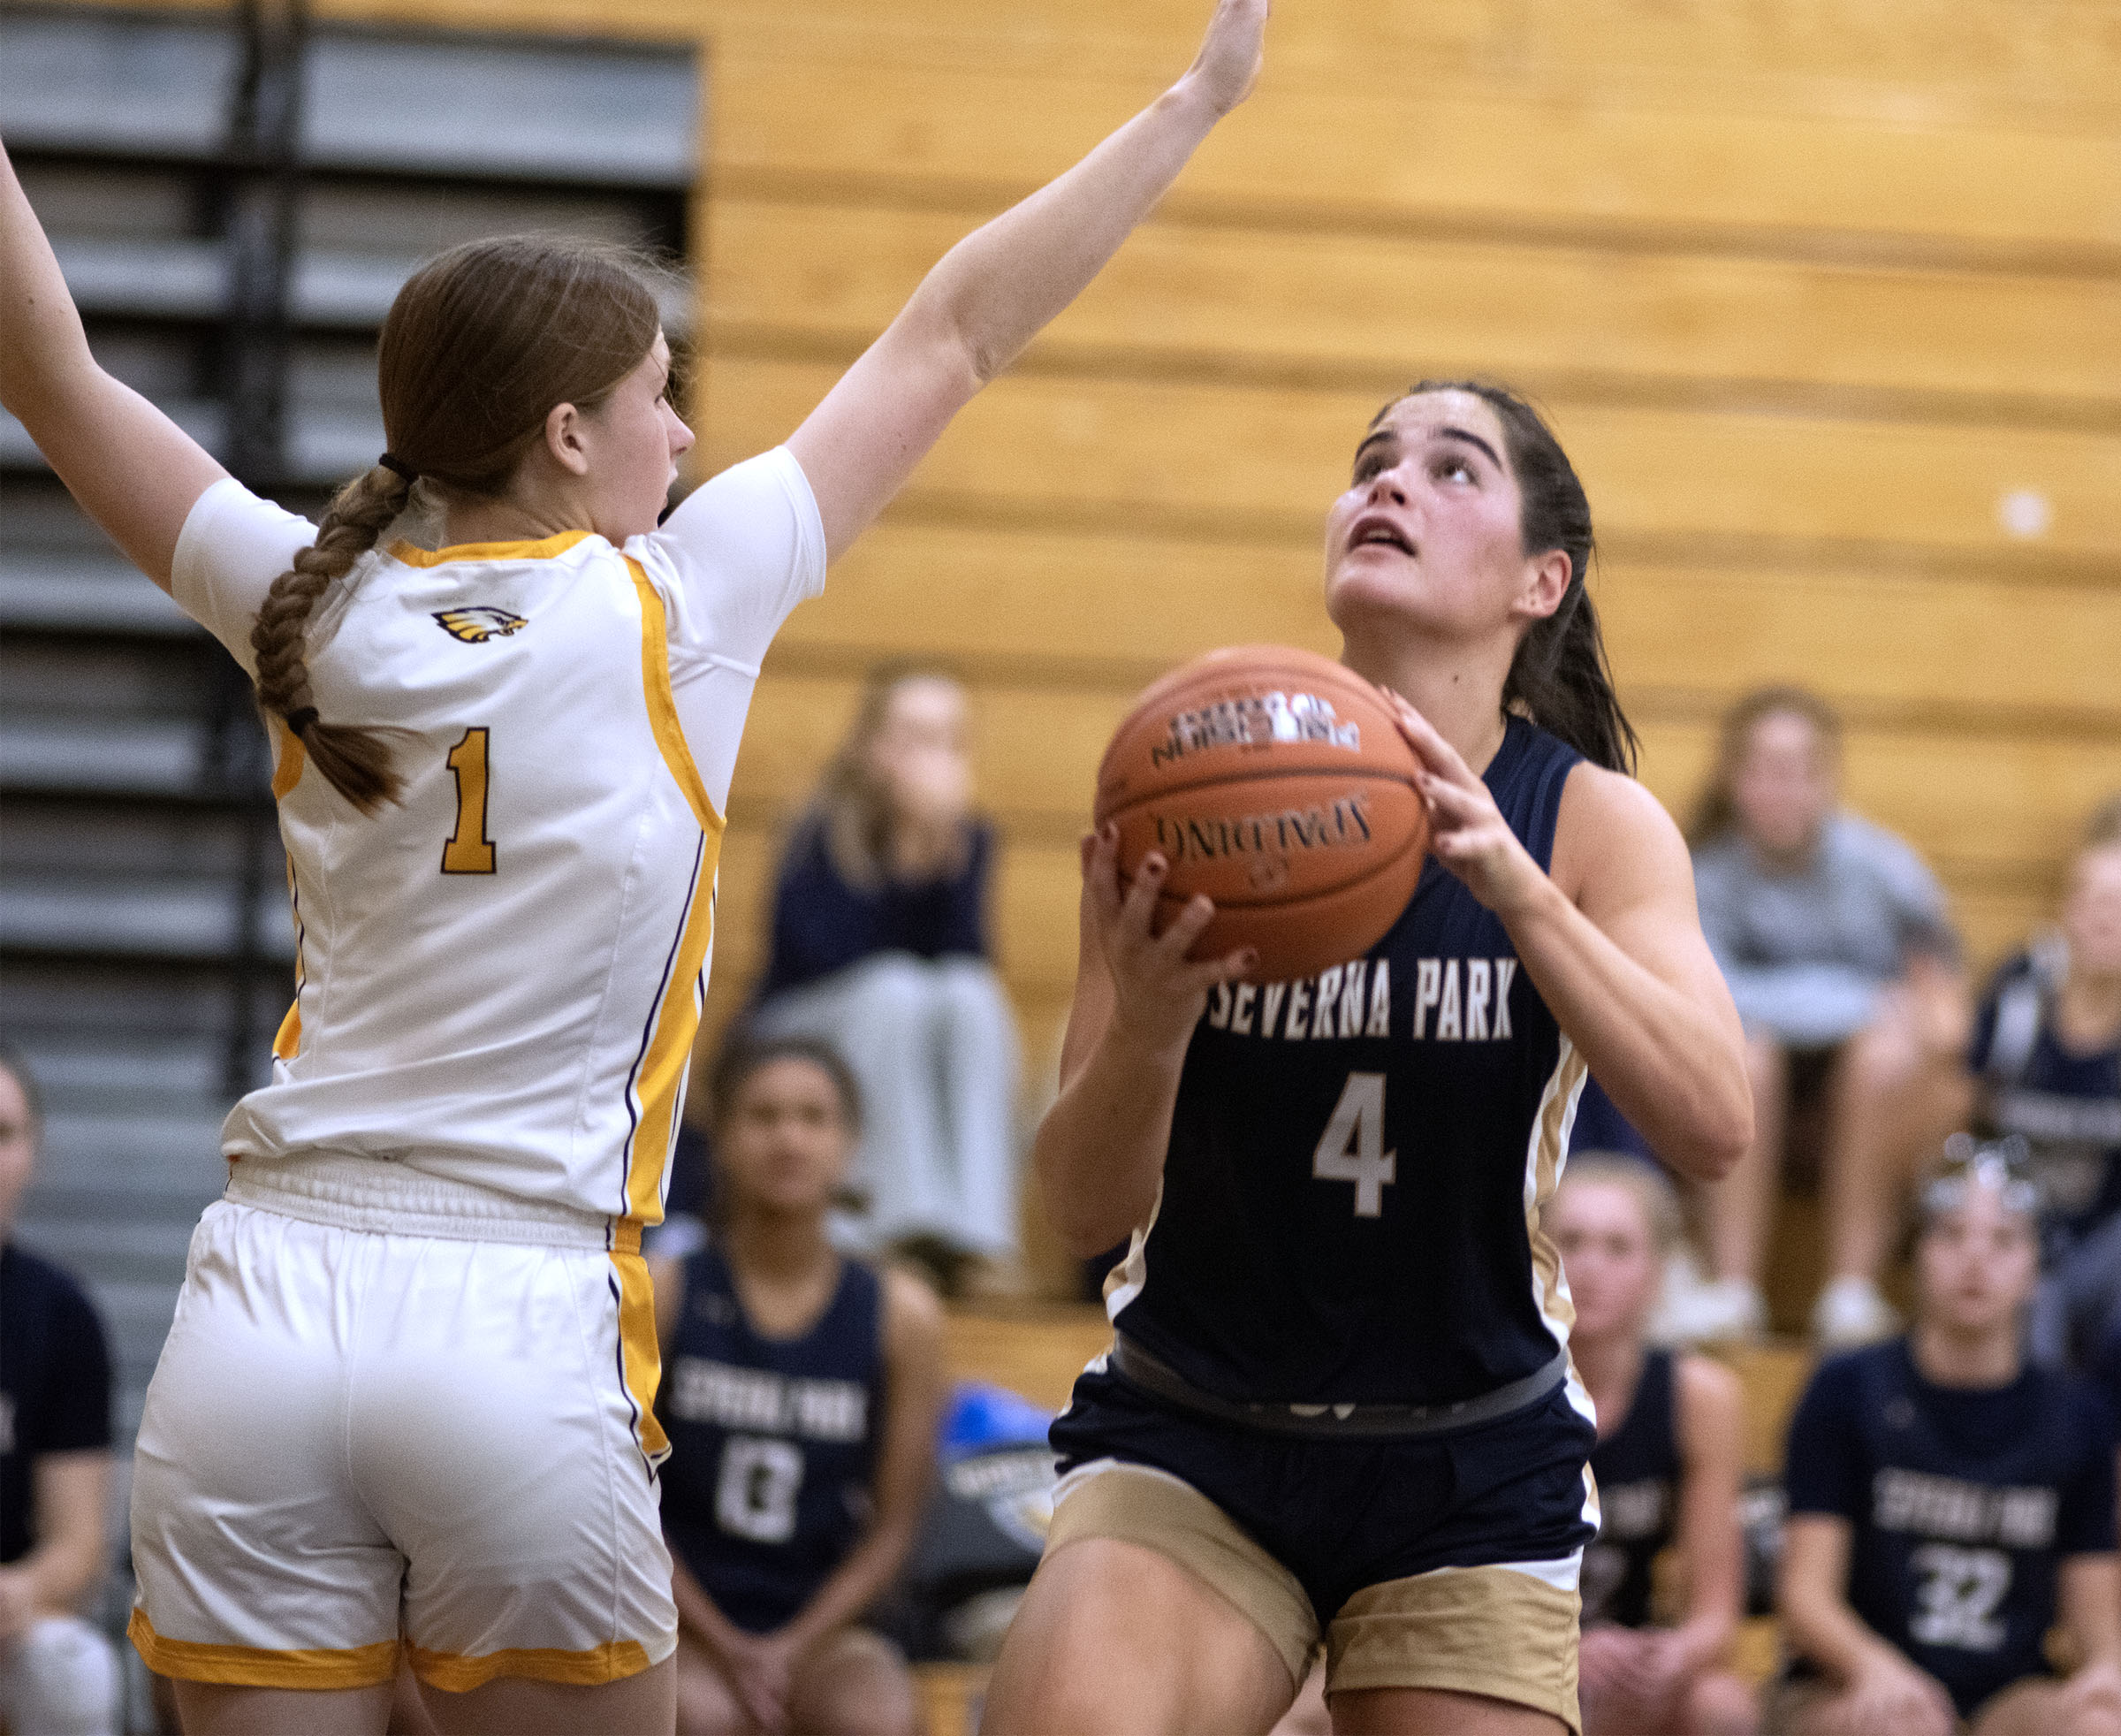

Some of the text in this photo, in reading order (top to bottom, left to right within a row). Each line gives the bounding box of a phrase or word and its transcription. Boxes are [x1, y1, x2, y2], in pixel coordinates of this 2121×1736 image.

[440, 726, 497, 874] 1
[1209, 957, 1518, 1041] SEVERNA PARK
[1311, 1071, 1396, 1219] 4
